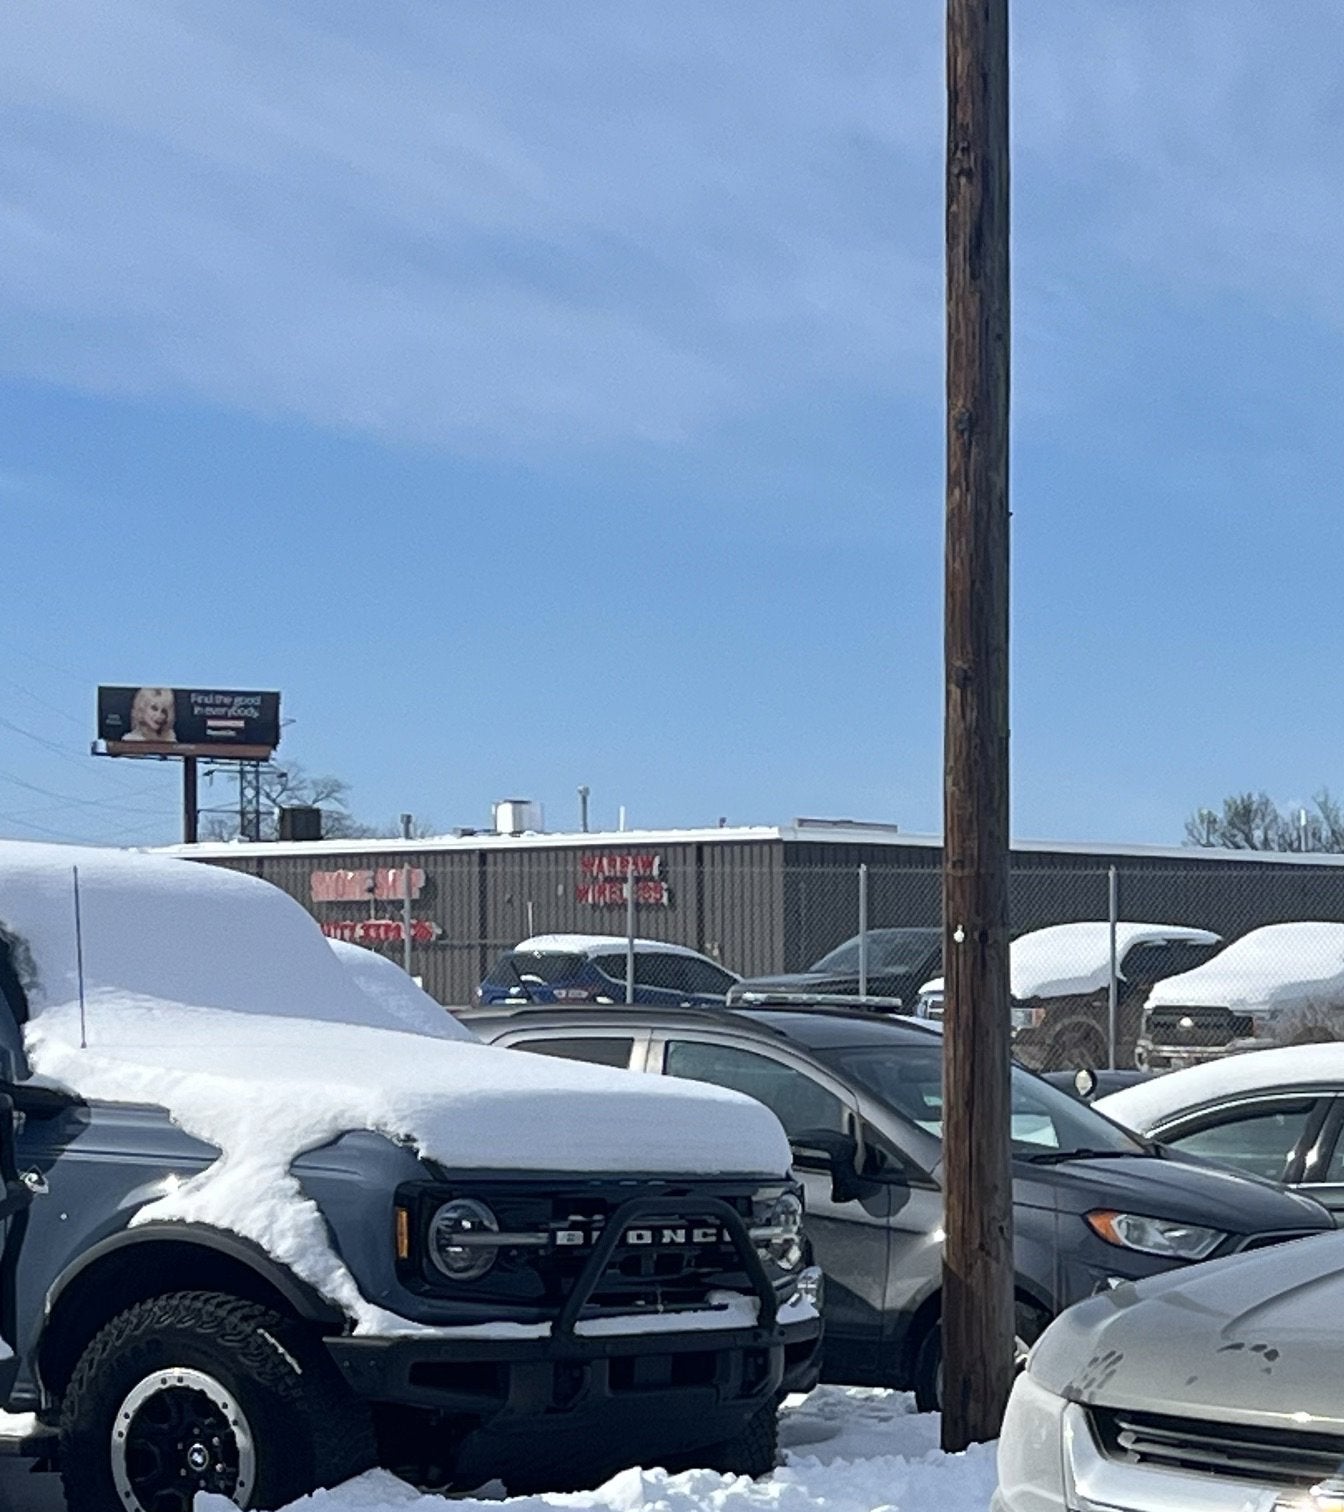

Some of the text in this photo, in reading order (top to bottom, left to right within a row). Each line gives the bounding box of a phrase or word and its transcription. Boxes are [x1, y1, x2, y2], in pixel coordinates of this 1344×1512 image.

[191, 692, 261, 707] Find the good
